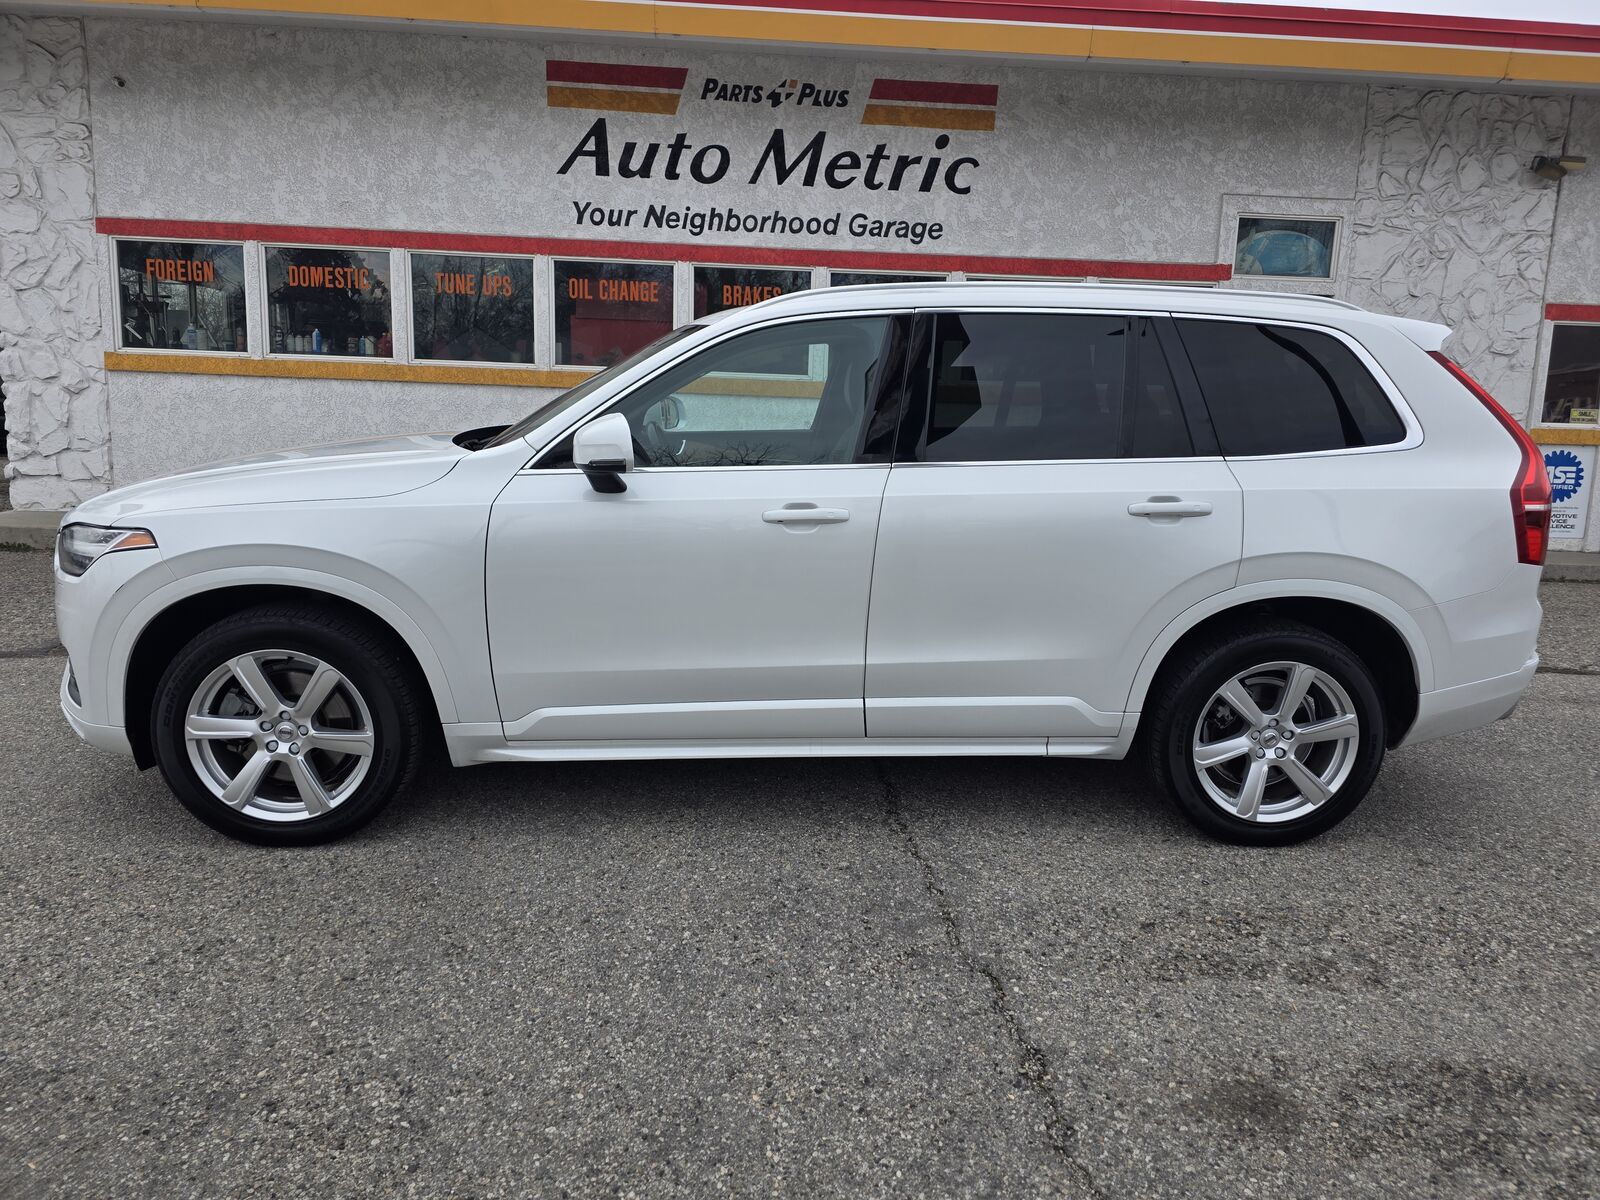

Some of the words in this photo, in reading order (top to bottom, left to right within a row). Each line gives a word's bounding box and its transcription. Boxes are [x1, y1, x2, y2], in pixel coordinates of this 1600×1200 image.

[701, 78, 763, 103] PARTS
[797, 82, 850, 108] PLUS
[556, 117, 731, 185] Auto
[749, 128, 980, 195] Metric
[572, 201, 638, 227] Your
[643, 204, 841, 237] Neighborhood
[849, 213, 944, 244] Garage
[145, 258, 215, 283] FOREIGN
[288, 265, 371, 290] DOMESTIC
[436, 272, 475, 295] TUNE
[482, 275, 512, 298] UPS
[568, 278, 593, 300] OIL
[599, 279, 659, 303] CHANGE
